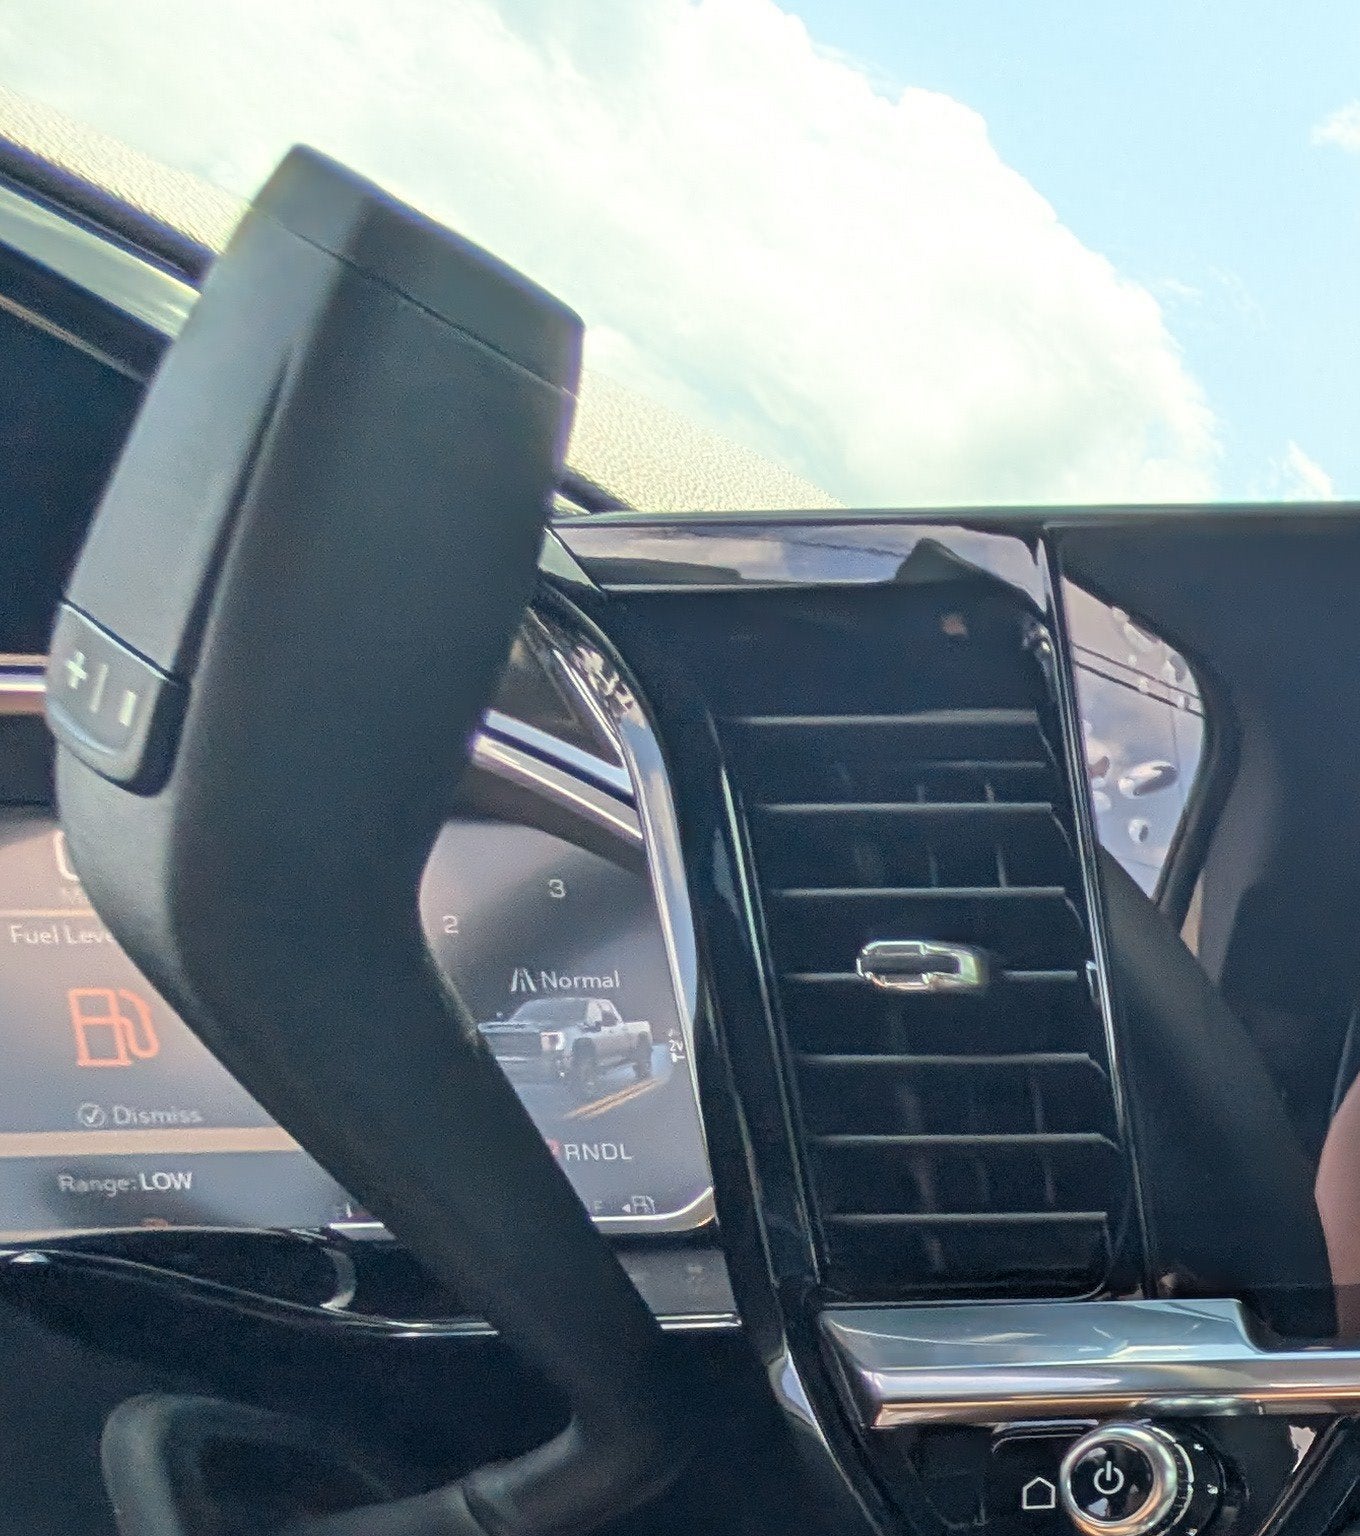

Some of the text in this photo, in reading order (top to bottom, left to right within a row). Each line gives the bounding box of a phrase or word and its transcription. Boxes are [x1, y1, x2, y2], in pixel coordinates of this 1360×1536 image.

[10, 924, 60, 943] Fuel
[541, 970, 621, 990] Normal
[112, 1106, 202, 1124] Dismiss
[59, 1173, 193, 1197] Range: LOW
